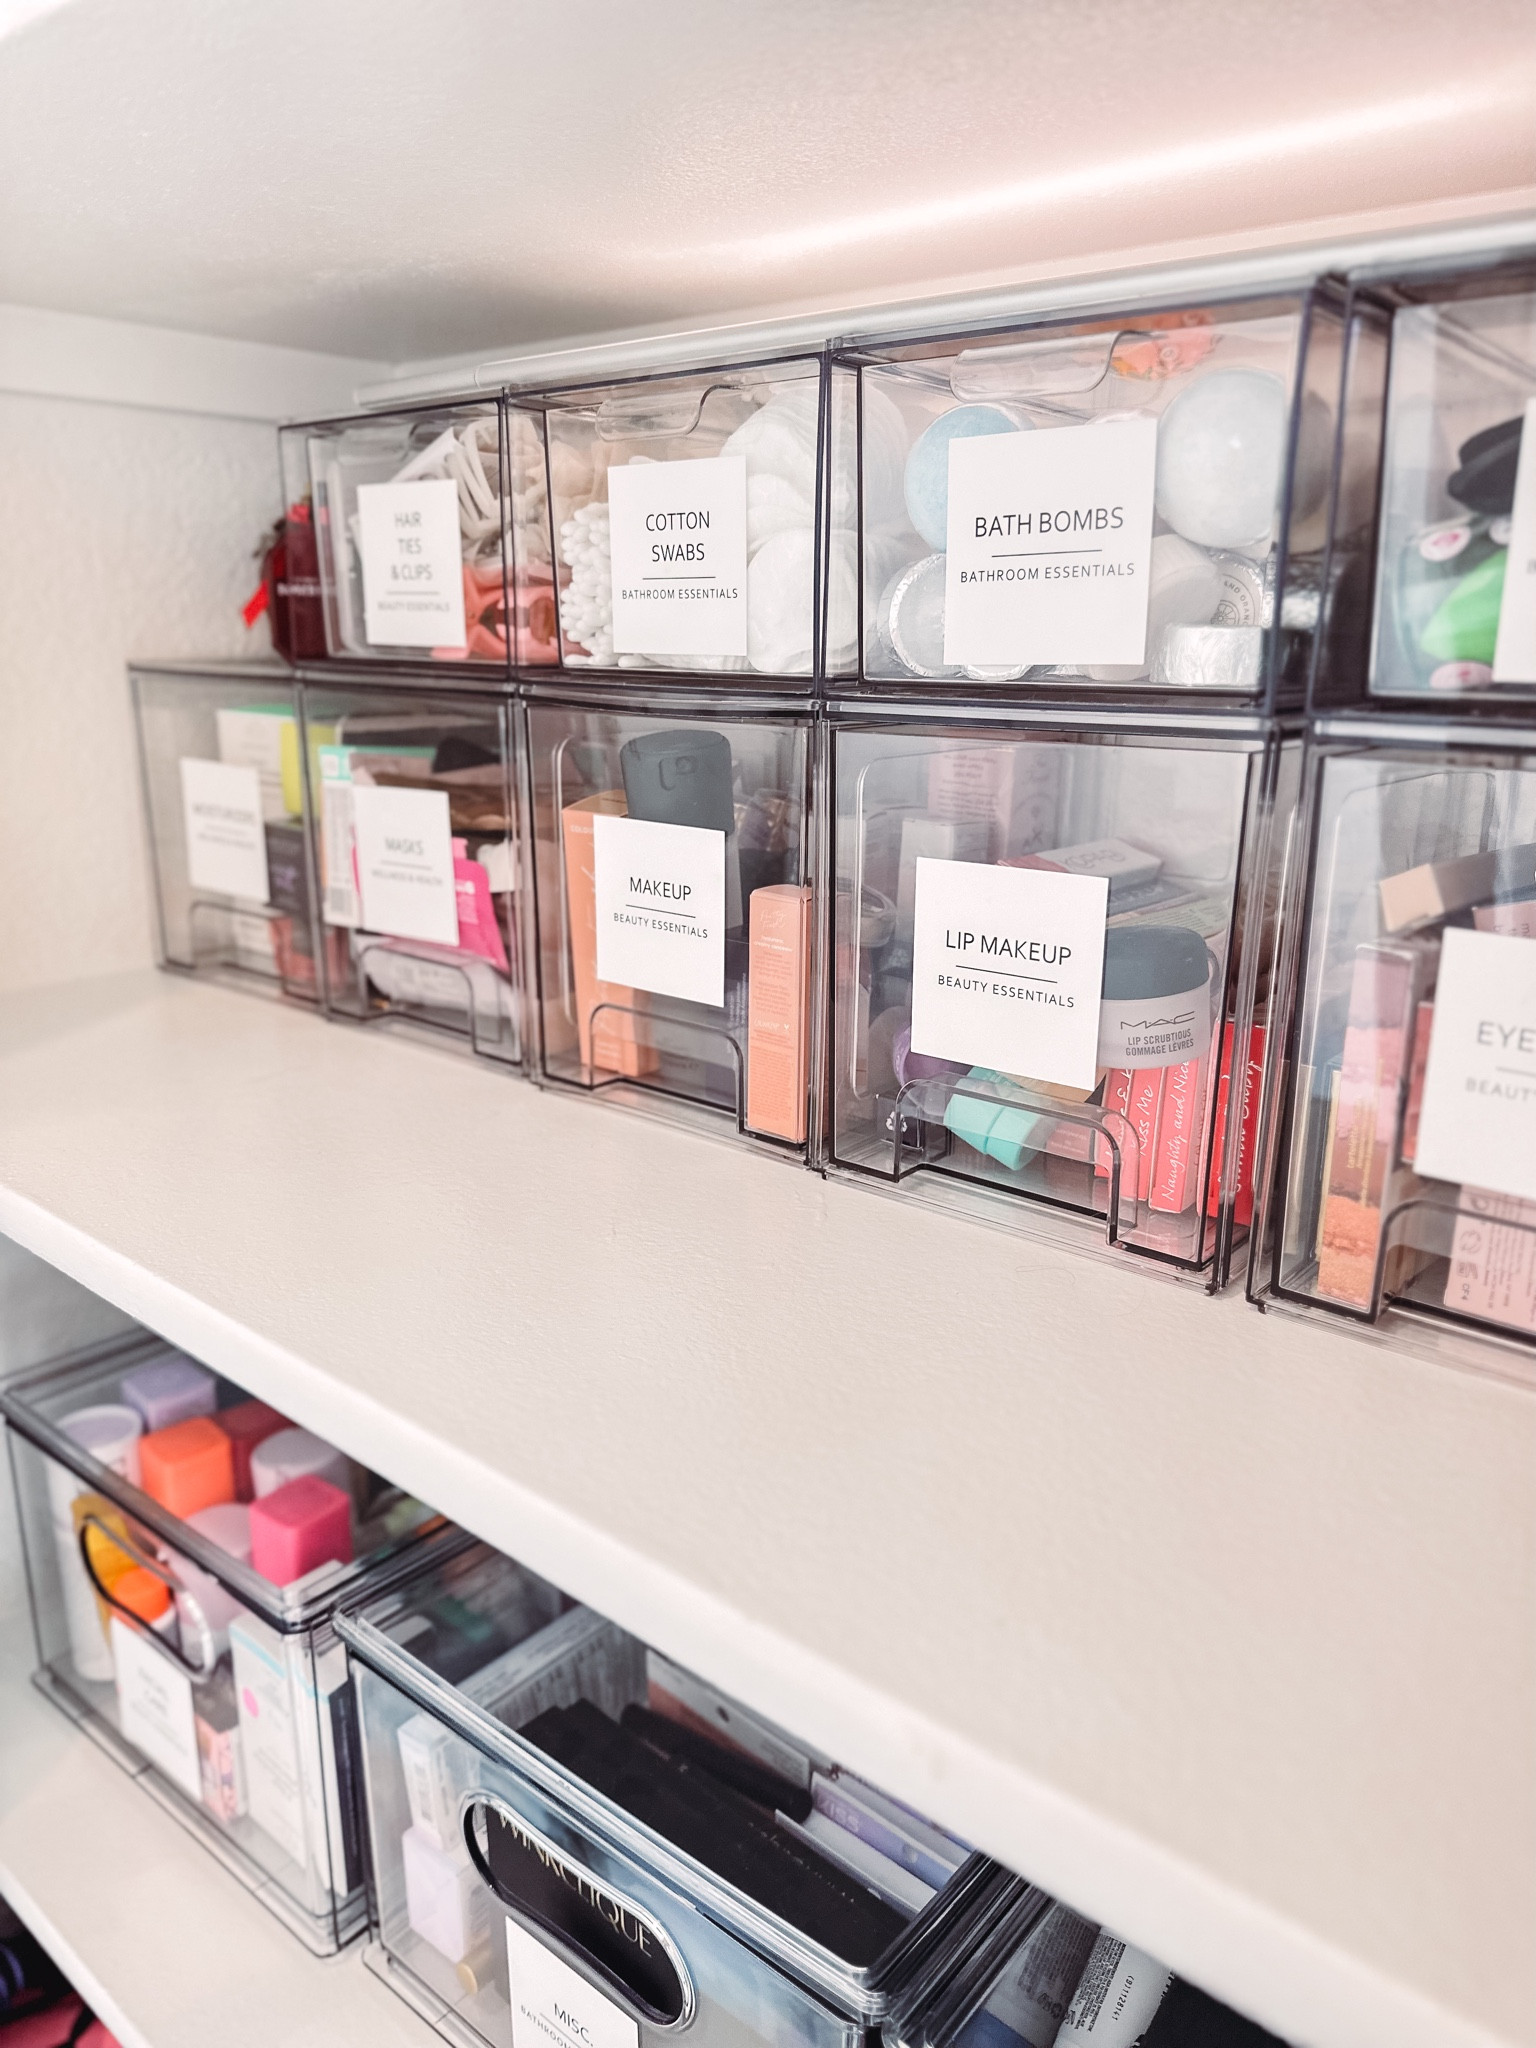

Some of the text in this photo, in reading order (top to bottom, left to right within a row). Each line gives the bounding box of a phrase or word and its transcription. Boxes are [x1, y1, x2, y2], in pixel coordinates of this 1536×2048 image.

[645, 510, 710, 532] COTTON
[975, 506, 1124, 538] BATH BOMBS
[397, 537, 423, 555] TIES
[651, 543, 705, 563] SWABS
[401, 564, 433, 581] CLIPS
[960, 562, 1135, 583] BATHROOM ESSENTIALS
[622, 587, 738, 600] BATHROOM ESSENTIALS
[629, 876, 692, 902] MAKEUP
[613, 912, 708, 939] BEAUTY ESSENTIALS
[946, 929, 1072, 967] LIP MAKEUP
[938, 974, 1075, 1009] BEAUTY ESSENTIALS
[1127, 1028, 1192, 1046] LIP SCRUBTIOUS
[1125, 1044, 1167, 1057] GOMMAGE
[1136, 1084, 1154, 1116] Me
[1465, 1076, 1536, 1102] BEAUT
[1169, 1093, 1185, 1129] and
[1161, 1134, 1189, 1201] Naughty
[553, 2002, 594, 2047] MISC.
